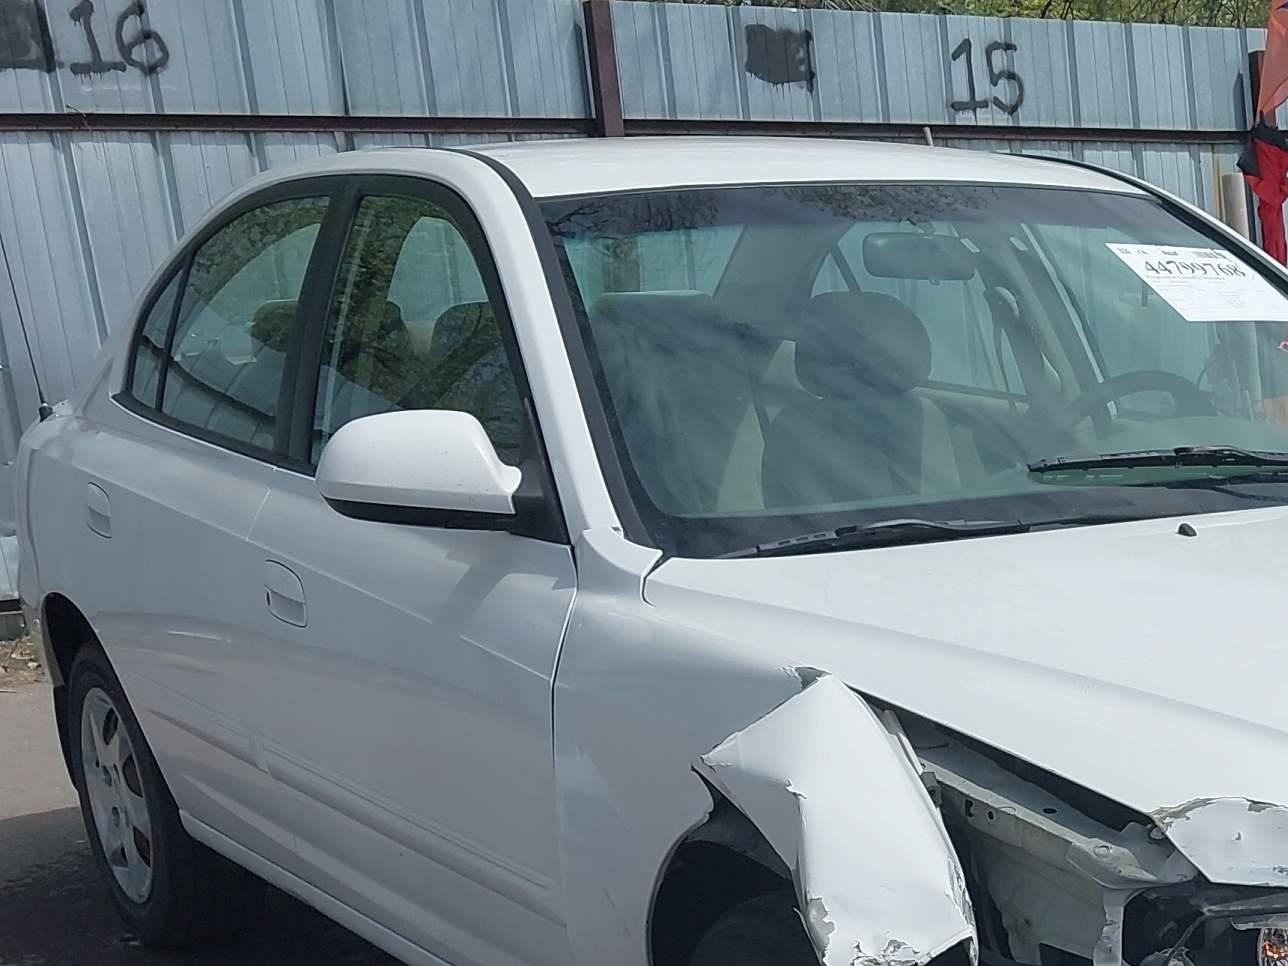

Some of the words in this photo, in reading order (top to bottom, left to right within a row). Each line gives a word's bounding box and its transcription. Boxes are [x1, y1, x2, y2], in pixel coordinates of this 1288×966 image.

[69, 0, 169, 77] 16
[950, 38, 1024, 115] 15
[1144, 260, 1247, 277] 44799768
